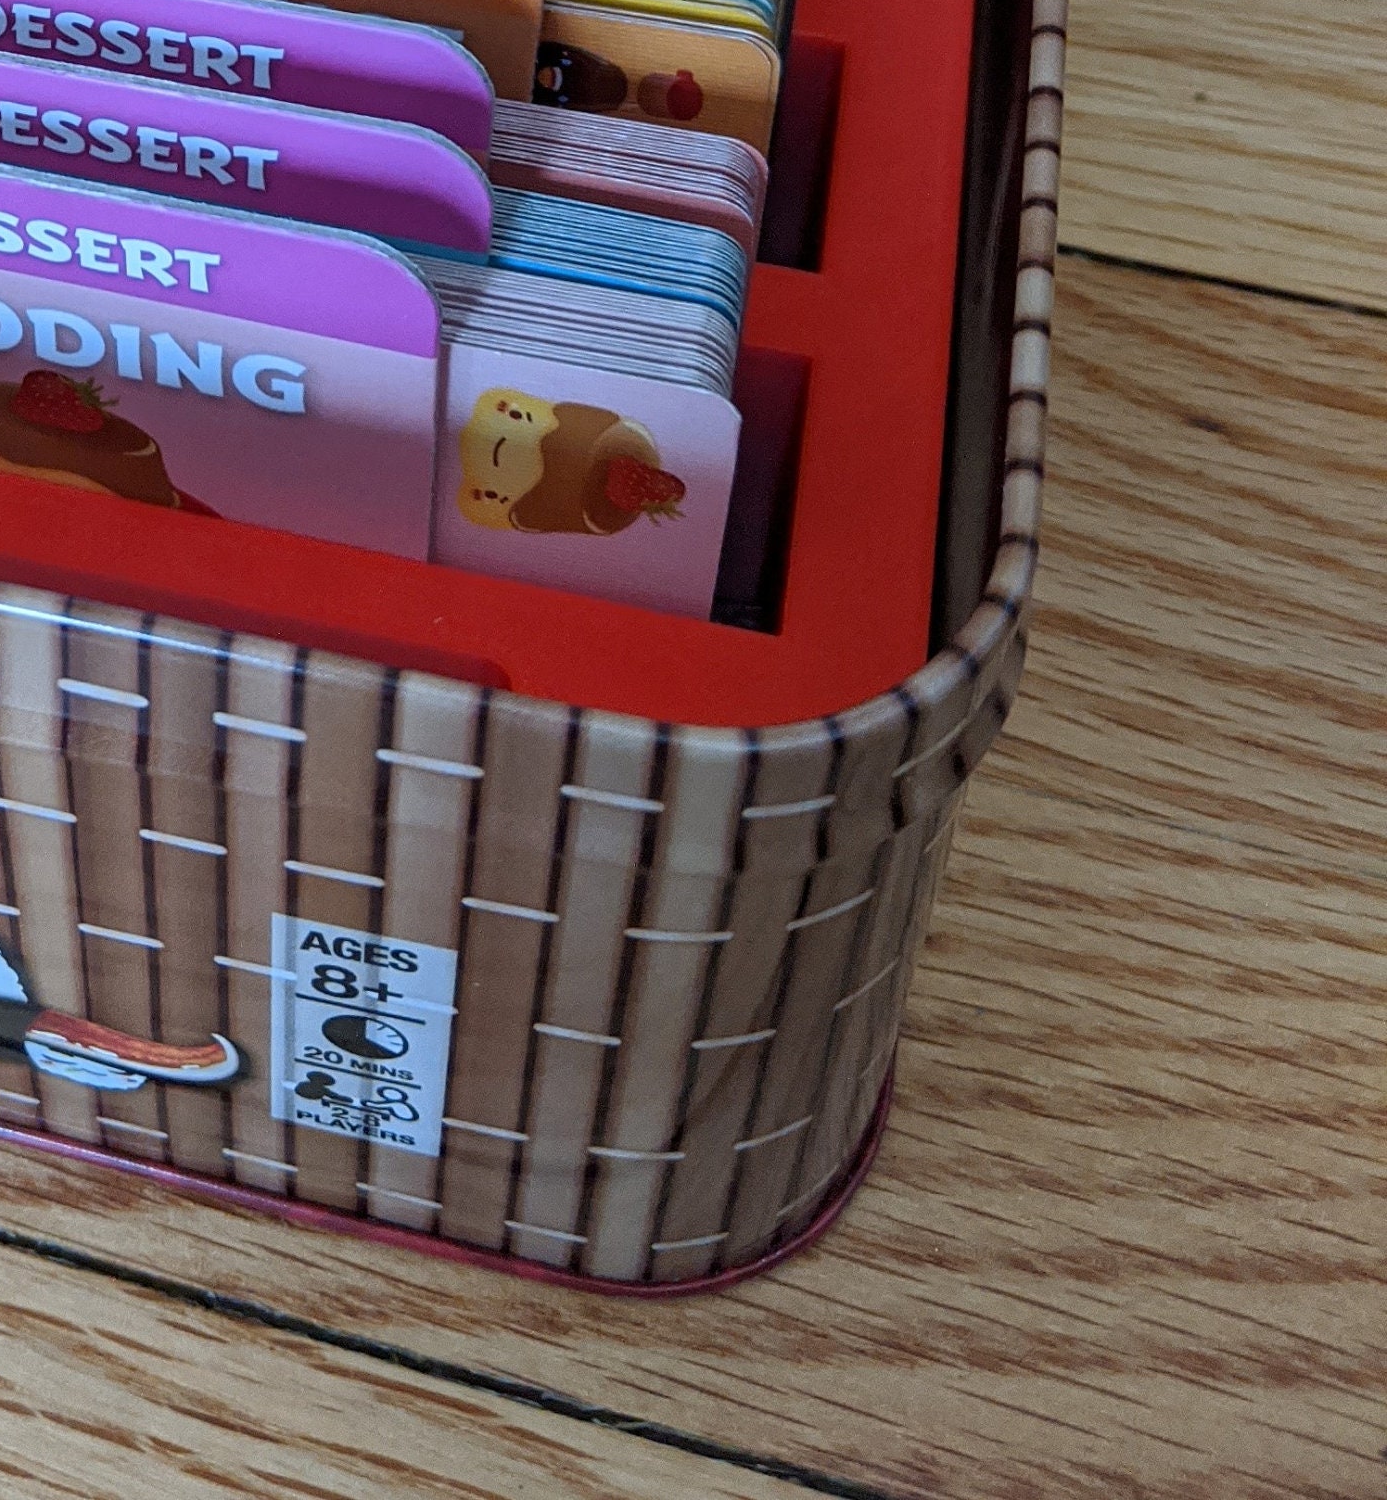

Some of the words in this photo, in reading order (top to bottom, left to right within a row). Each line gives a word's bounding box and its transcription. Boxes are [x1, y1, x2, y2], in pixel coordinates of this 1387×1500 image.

[300, 931, 418, 973] AGES
[311, 964, 404, 1002] 8+
[303, 1045, 344, 1065] 20
[349, 1059, 415, 1081] MINS
[296, 1109, 416, 1146] PLAYERS
